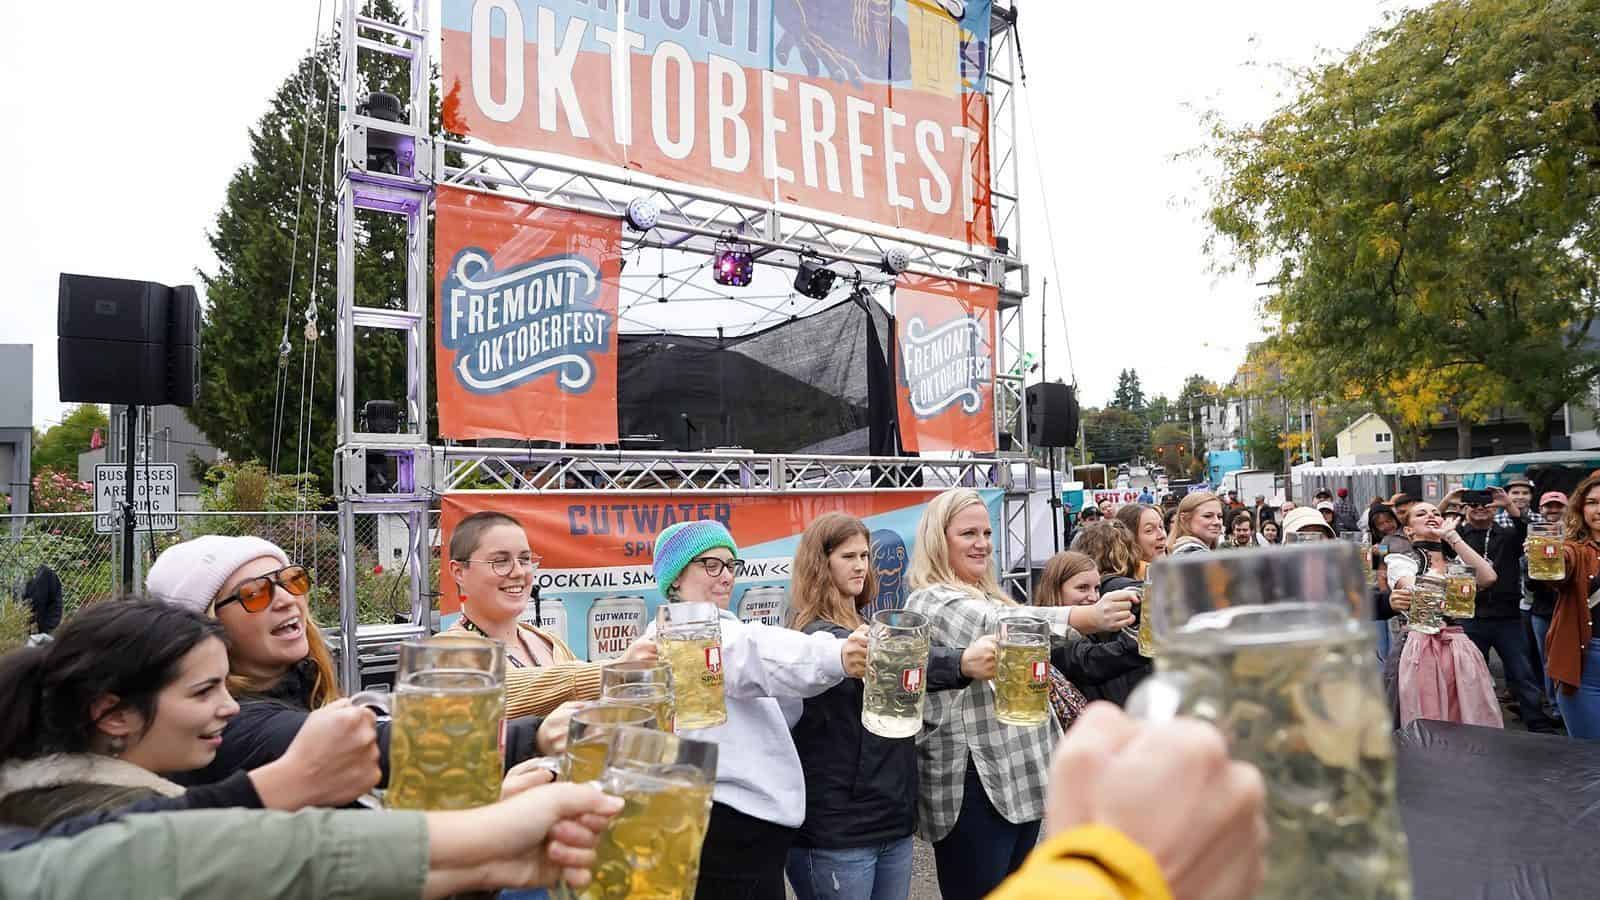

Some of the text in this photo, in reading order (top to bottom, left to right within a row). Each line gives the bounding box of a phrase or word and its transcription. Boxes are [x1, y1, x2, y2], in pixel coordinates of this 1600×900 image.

[470, 0, 978, 223] OKTOBERFEST
[451, 272, 580, 340] FREMONT
[479, 312, 606, 374] OKTOBERFEST
[905, 328, 974, 380] FREMONT
[920, 355, 990, 404] OKTOBERFEST
[99, 470, 173, 481] BUSIESSES
[104, 485, 170, 496] ARE OPEN
[114, 500, 160, 511] DRING
[100, 513, 174, 527] COUCTION
[568, 503, 732, 535] CUTWATER
[624, 542, 655, 557] SPI
[534, 572, 618, 588] OCKTAIL
[622, 571, 656, 585] SAM
[595, 612, 639, 622] CUTWATER
[594, 624, 639, 641] VODKA
